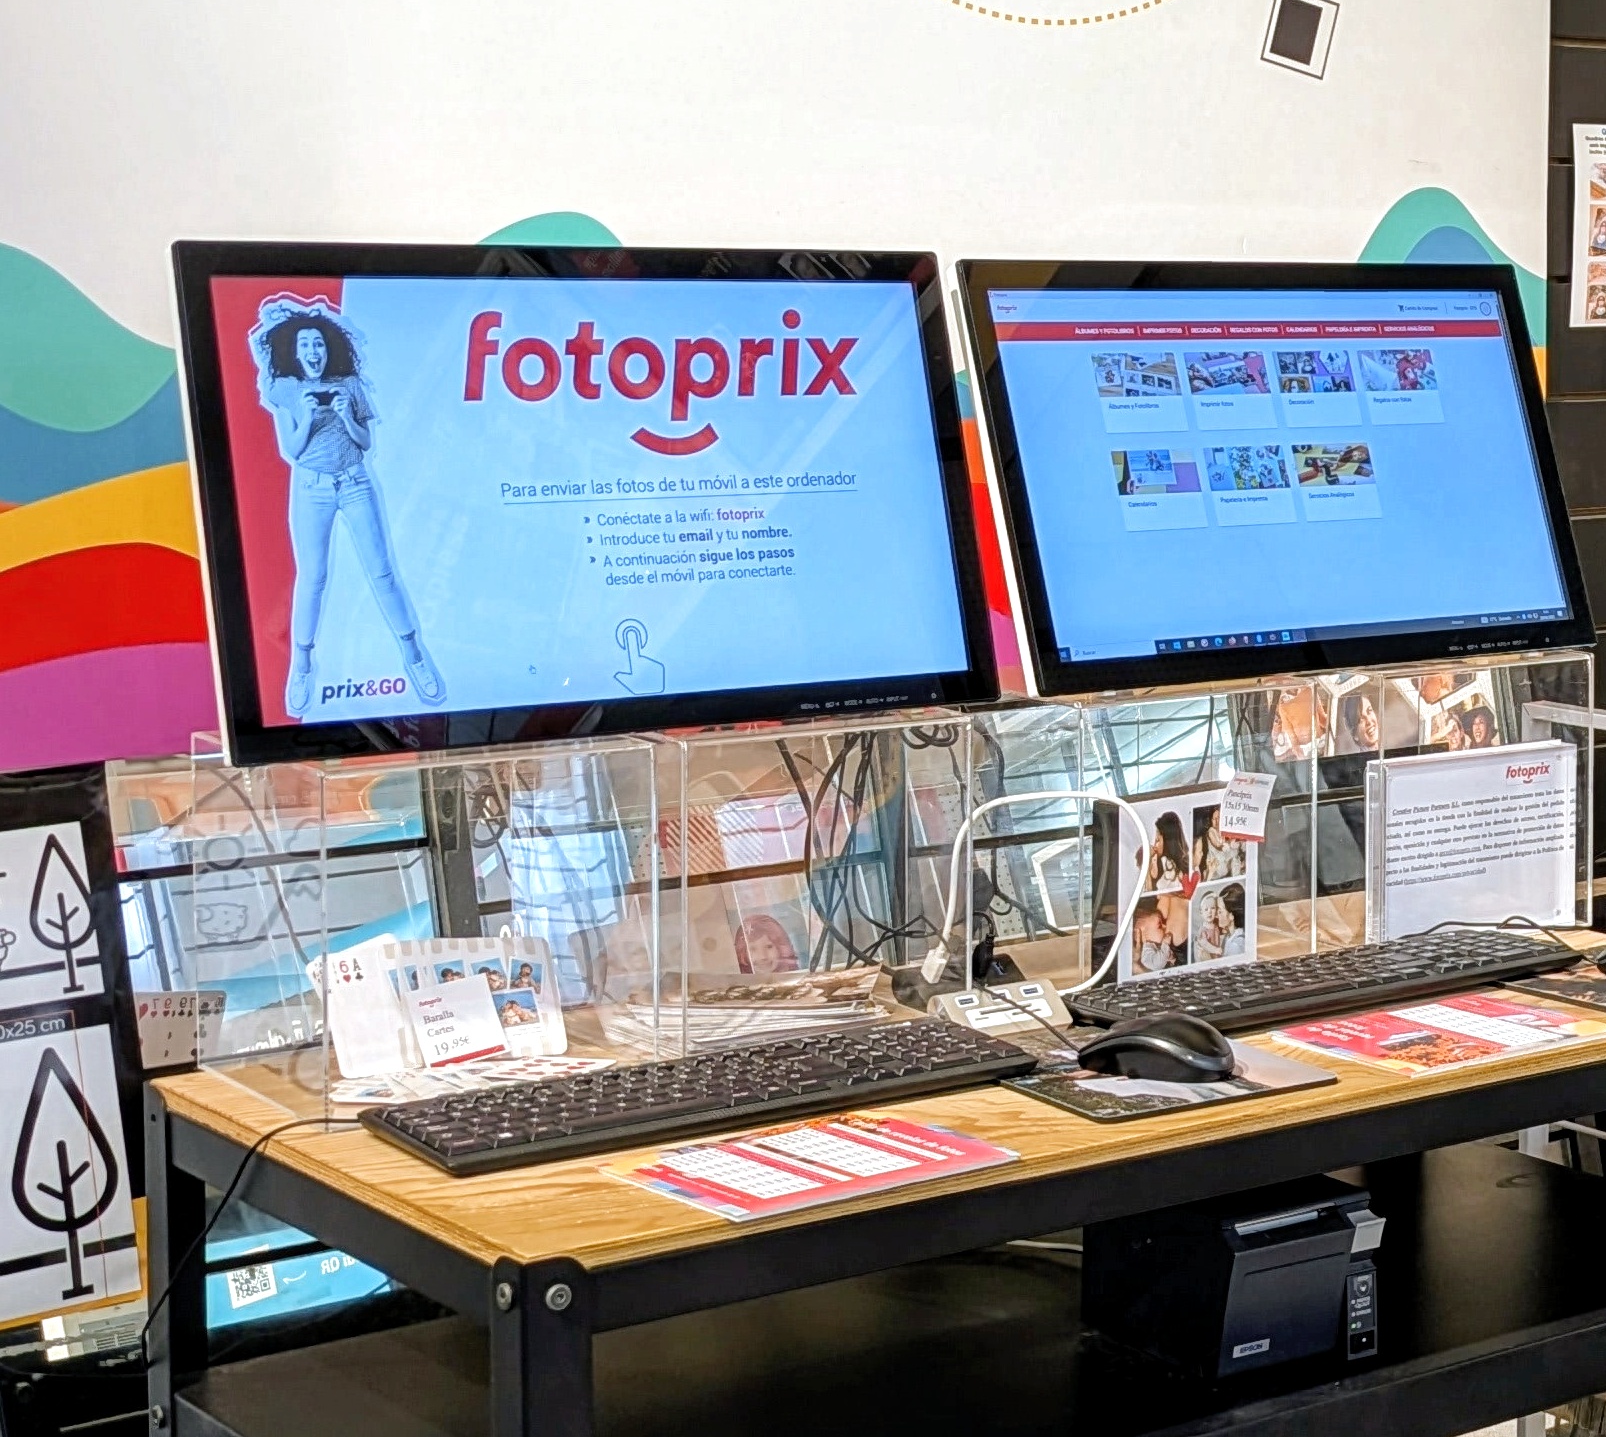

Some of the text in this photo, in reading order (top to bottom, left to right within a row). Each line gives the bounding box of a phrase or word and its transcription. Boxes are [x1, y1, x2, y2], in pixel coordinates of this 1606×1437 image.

[463, 310, 860, 423] fotoprix
[501, 471, 857, 498] Para enviar las fotos de tu móvil a este ordenador
[597, 510, 662, 526] Conéctate
[665, 513, 673, 523] a
[675, 510, 687, 523] la
[716, 507, 765, 524] fotoprix
[599, 525, 793, 546] Introduce tu email y tu nombre.
[603, 547, 795, 568] A continuación sigue los pasos
[605, 565, 797, 586] desde el móvil para conectarte.
[321, 677, 406, 705] prix&GO
[1506, 762, 1550, 779] fotoprix
[339, 960, 349, 973] 6
[352, 958, 362, 972] A
[40, 1017, 65, 1033] cm
[423, 1010, 454, 1025] Baralla
[427, 1025, 454, 1038] Cartes
[434, 1036, 471, 1056] 19.95€
[1239, 1343, 1263, 1354] EPSON
